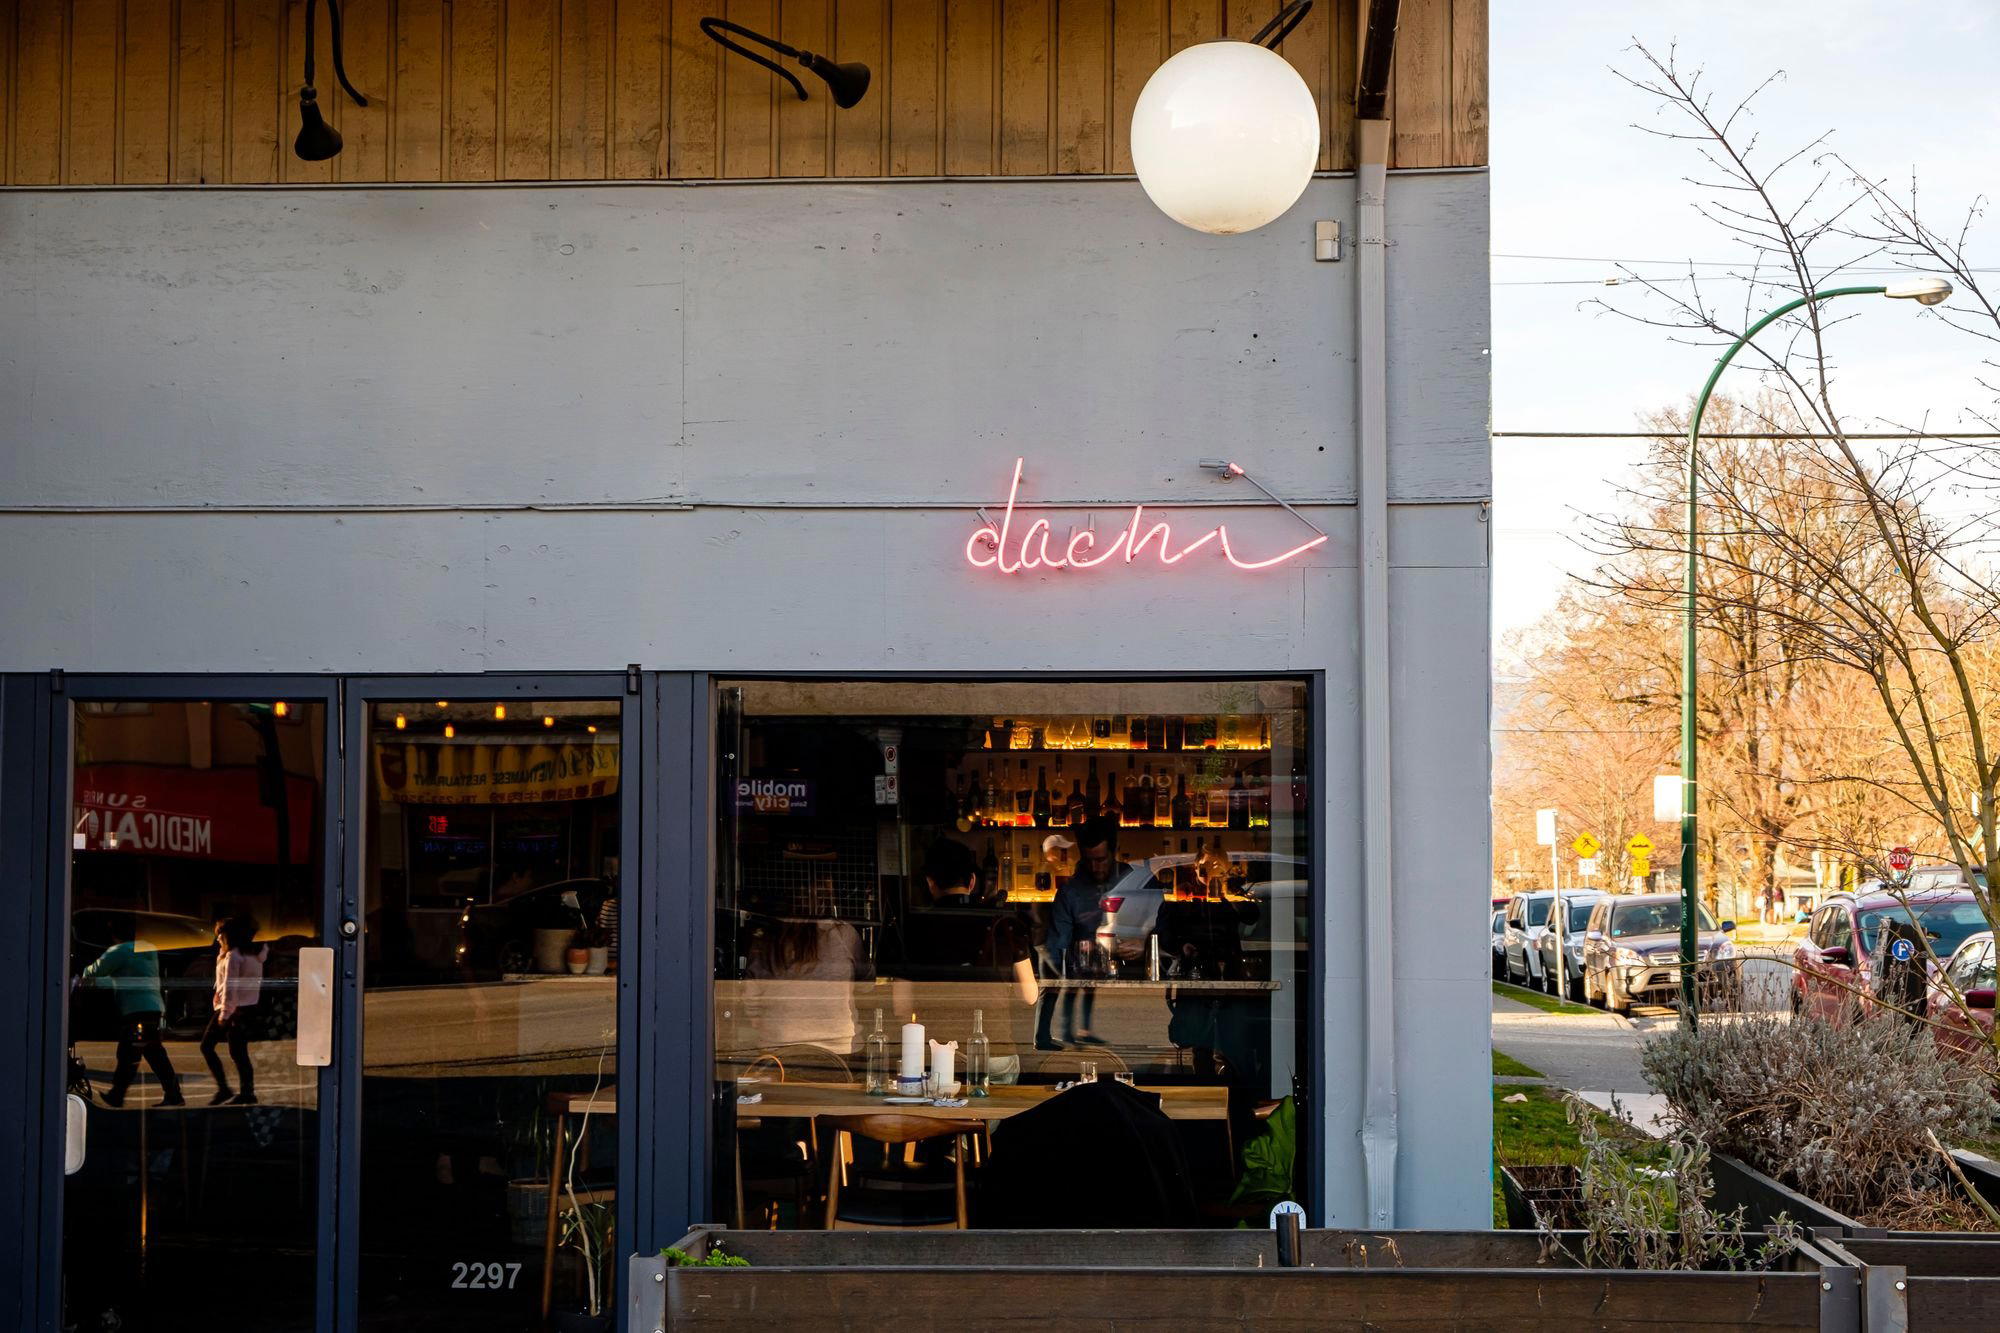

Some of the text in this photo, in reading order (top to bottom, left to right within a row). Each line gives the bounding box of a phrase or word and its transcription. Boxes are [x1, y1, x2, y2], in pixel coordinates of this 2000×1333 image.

[1890, 853, 1914, 865] STOP
[1582, 861, 1593, 869] 30
[1636, 862, 1647, 870] 30
[451, 1262, 522, 1289] 2297
